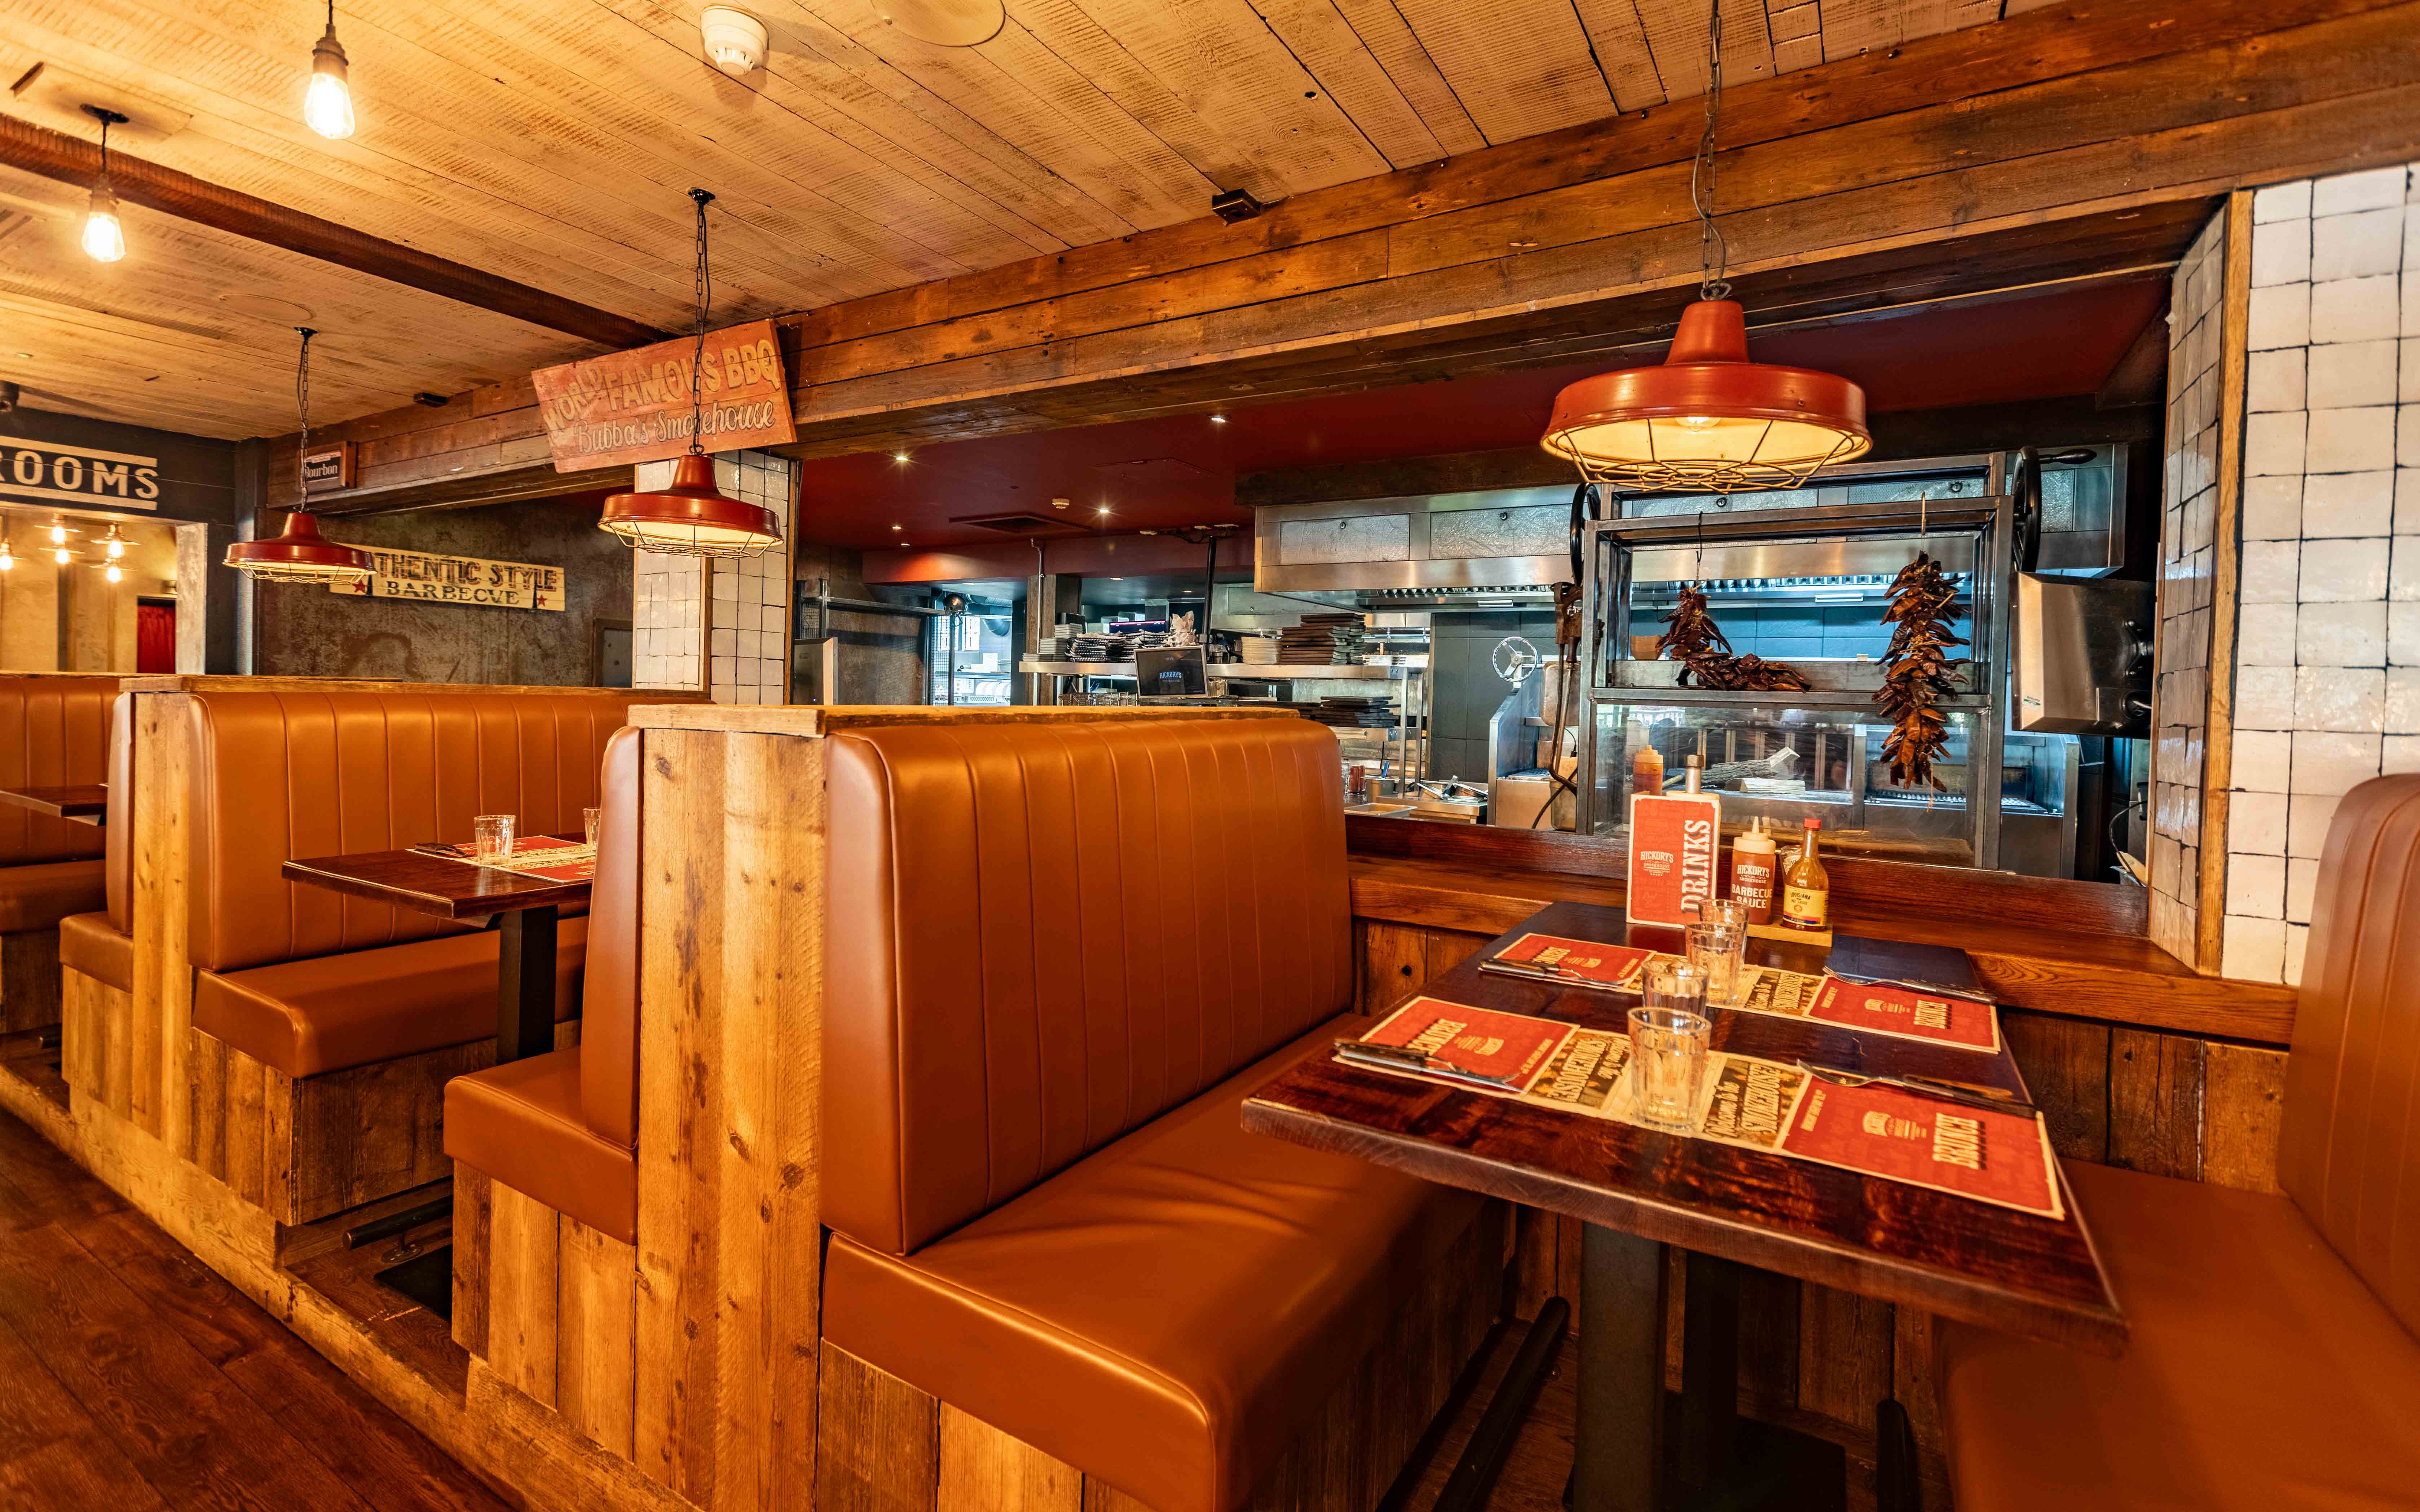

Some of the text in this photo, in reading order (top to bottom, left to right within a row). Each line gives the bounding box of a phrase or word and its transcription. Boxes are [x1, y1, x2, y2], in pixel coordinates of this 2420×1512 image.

[543, 339, 781, 434] WORLD FAMOUS BBQ
[574, 418, 650, 454] Bubba's
[305, 463, 338, 479] Bourbon
[375, 552, 557, 592] THENTIC STYLE
[1640, 850, 1674, 863] HICKORY'S
[1680, 819, 1711, 911] DRINKS
[1737, 865, 1770, 878] HICKORY'S
[1732, 883, 1773, 898] BARBECUE
[1736, 896, 1767, 908] SAUCE
[1913, 999, 1948, 1029] BRUNCH
[1703, 1081, 1740, 1138] Welcome to the
[1932, 1111, 1979, 1171] BRUNCH
